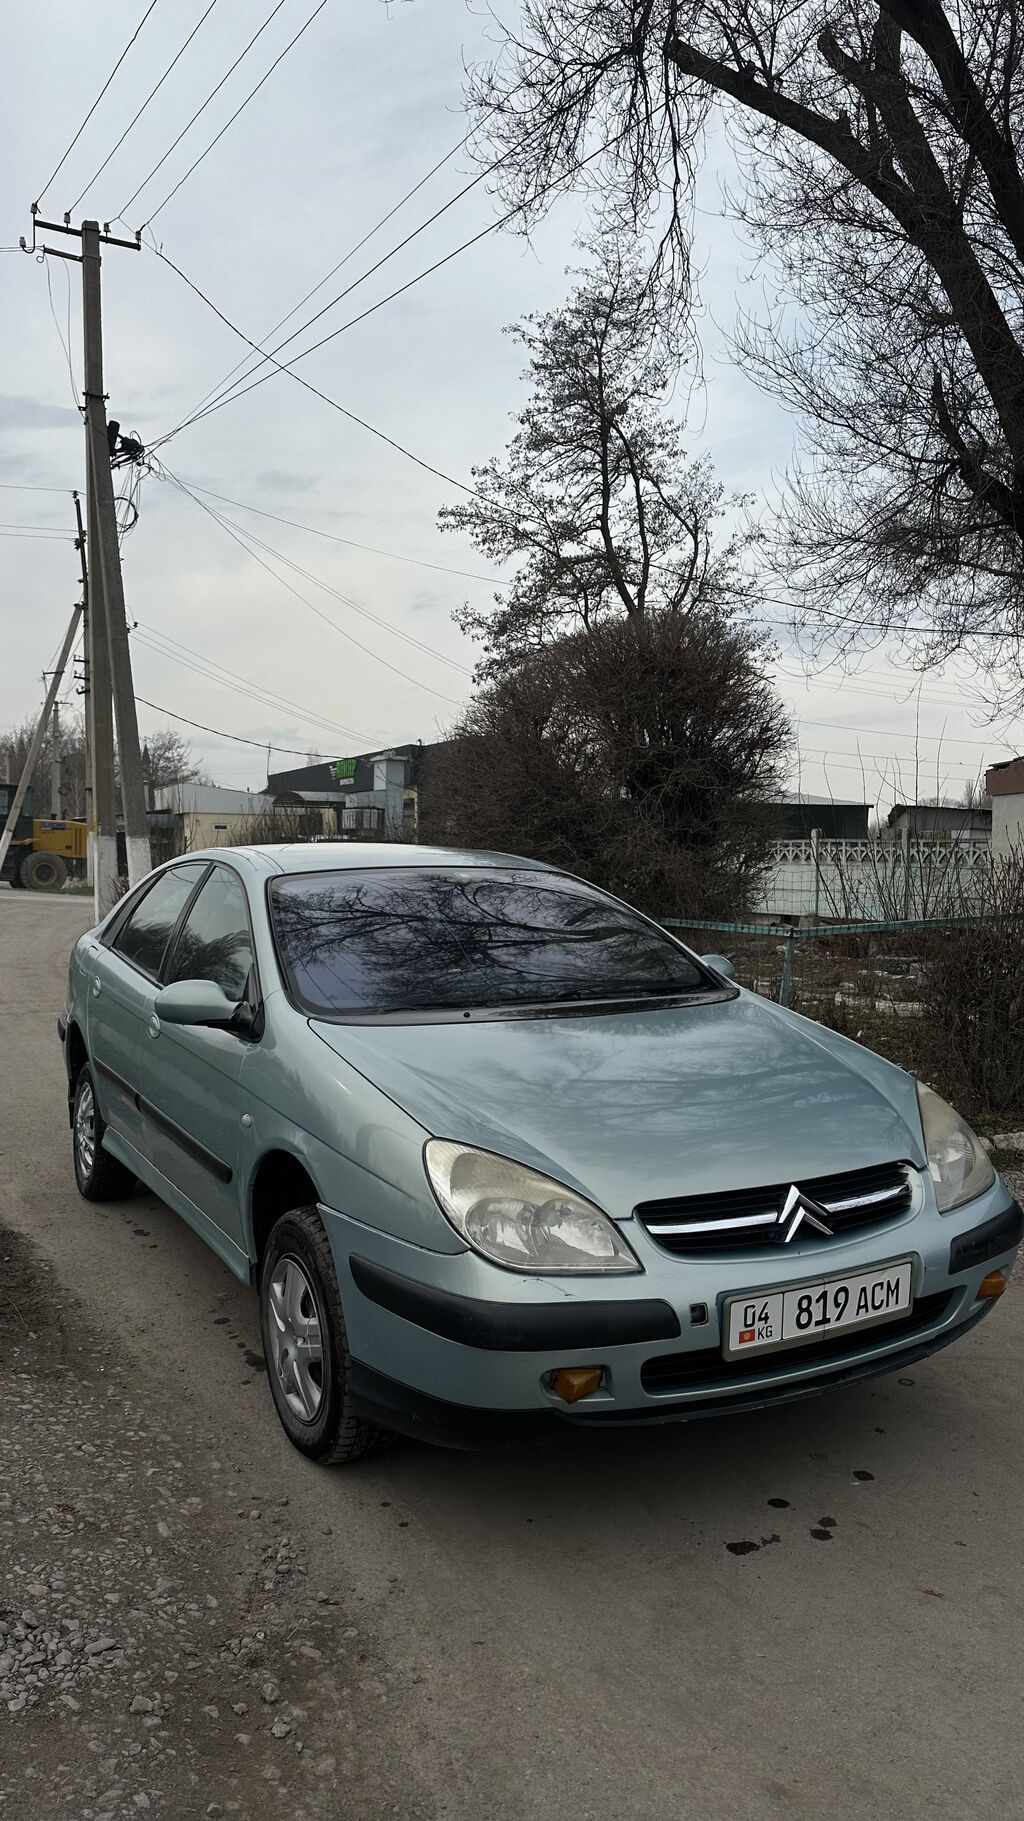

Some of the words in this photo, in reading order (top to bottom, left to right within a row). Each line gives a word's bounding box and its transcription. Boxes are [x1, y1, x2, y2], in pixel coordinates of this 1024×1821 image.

[743, 1301, 769, 1328] 04
[795, 1286, 850, 1330] 819
[855, 1277, 900, 1316] ACM
[757, 1326, 773, 1340] KG
